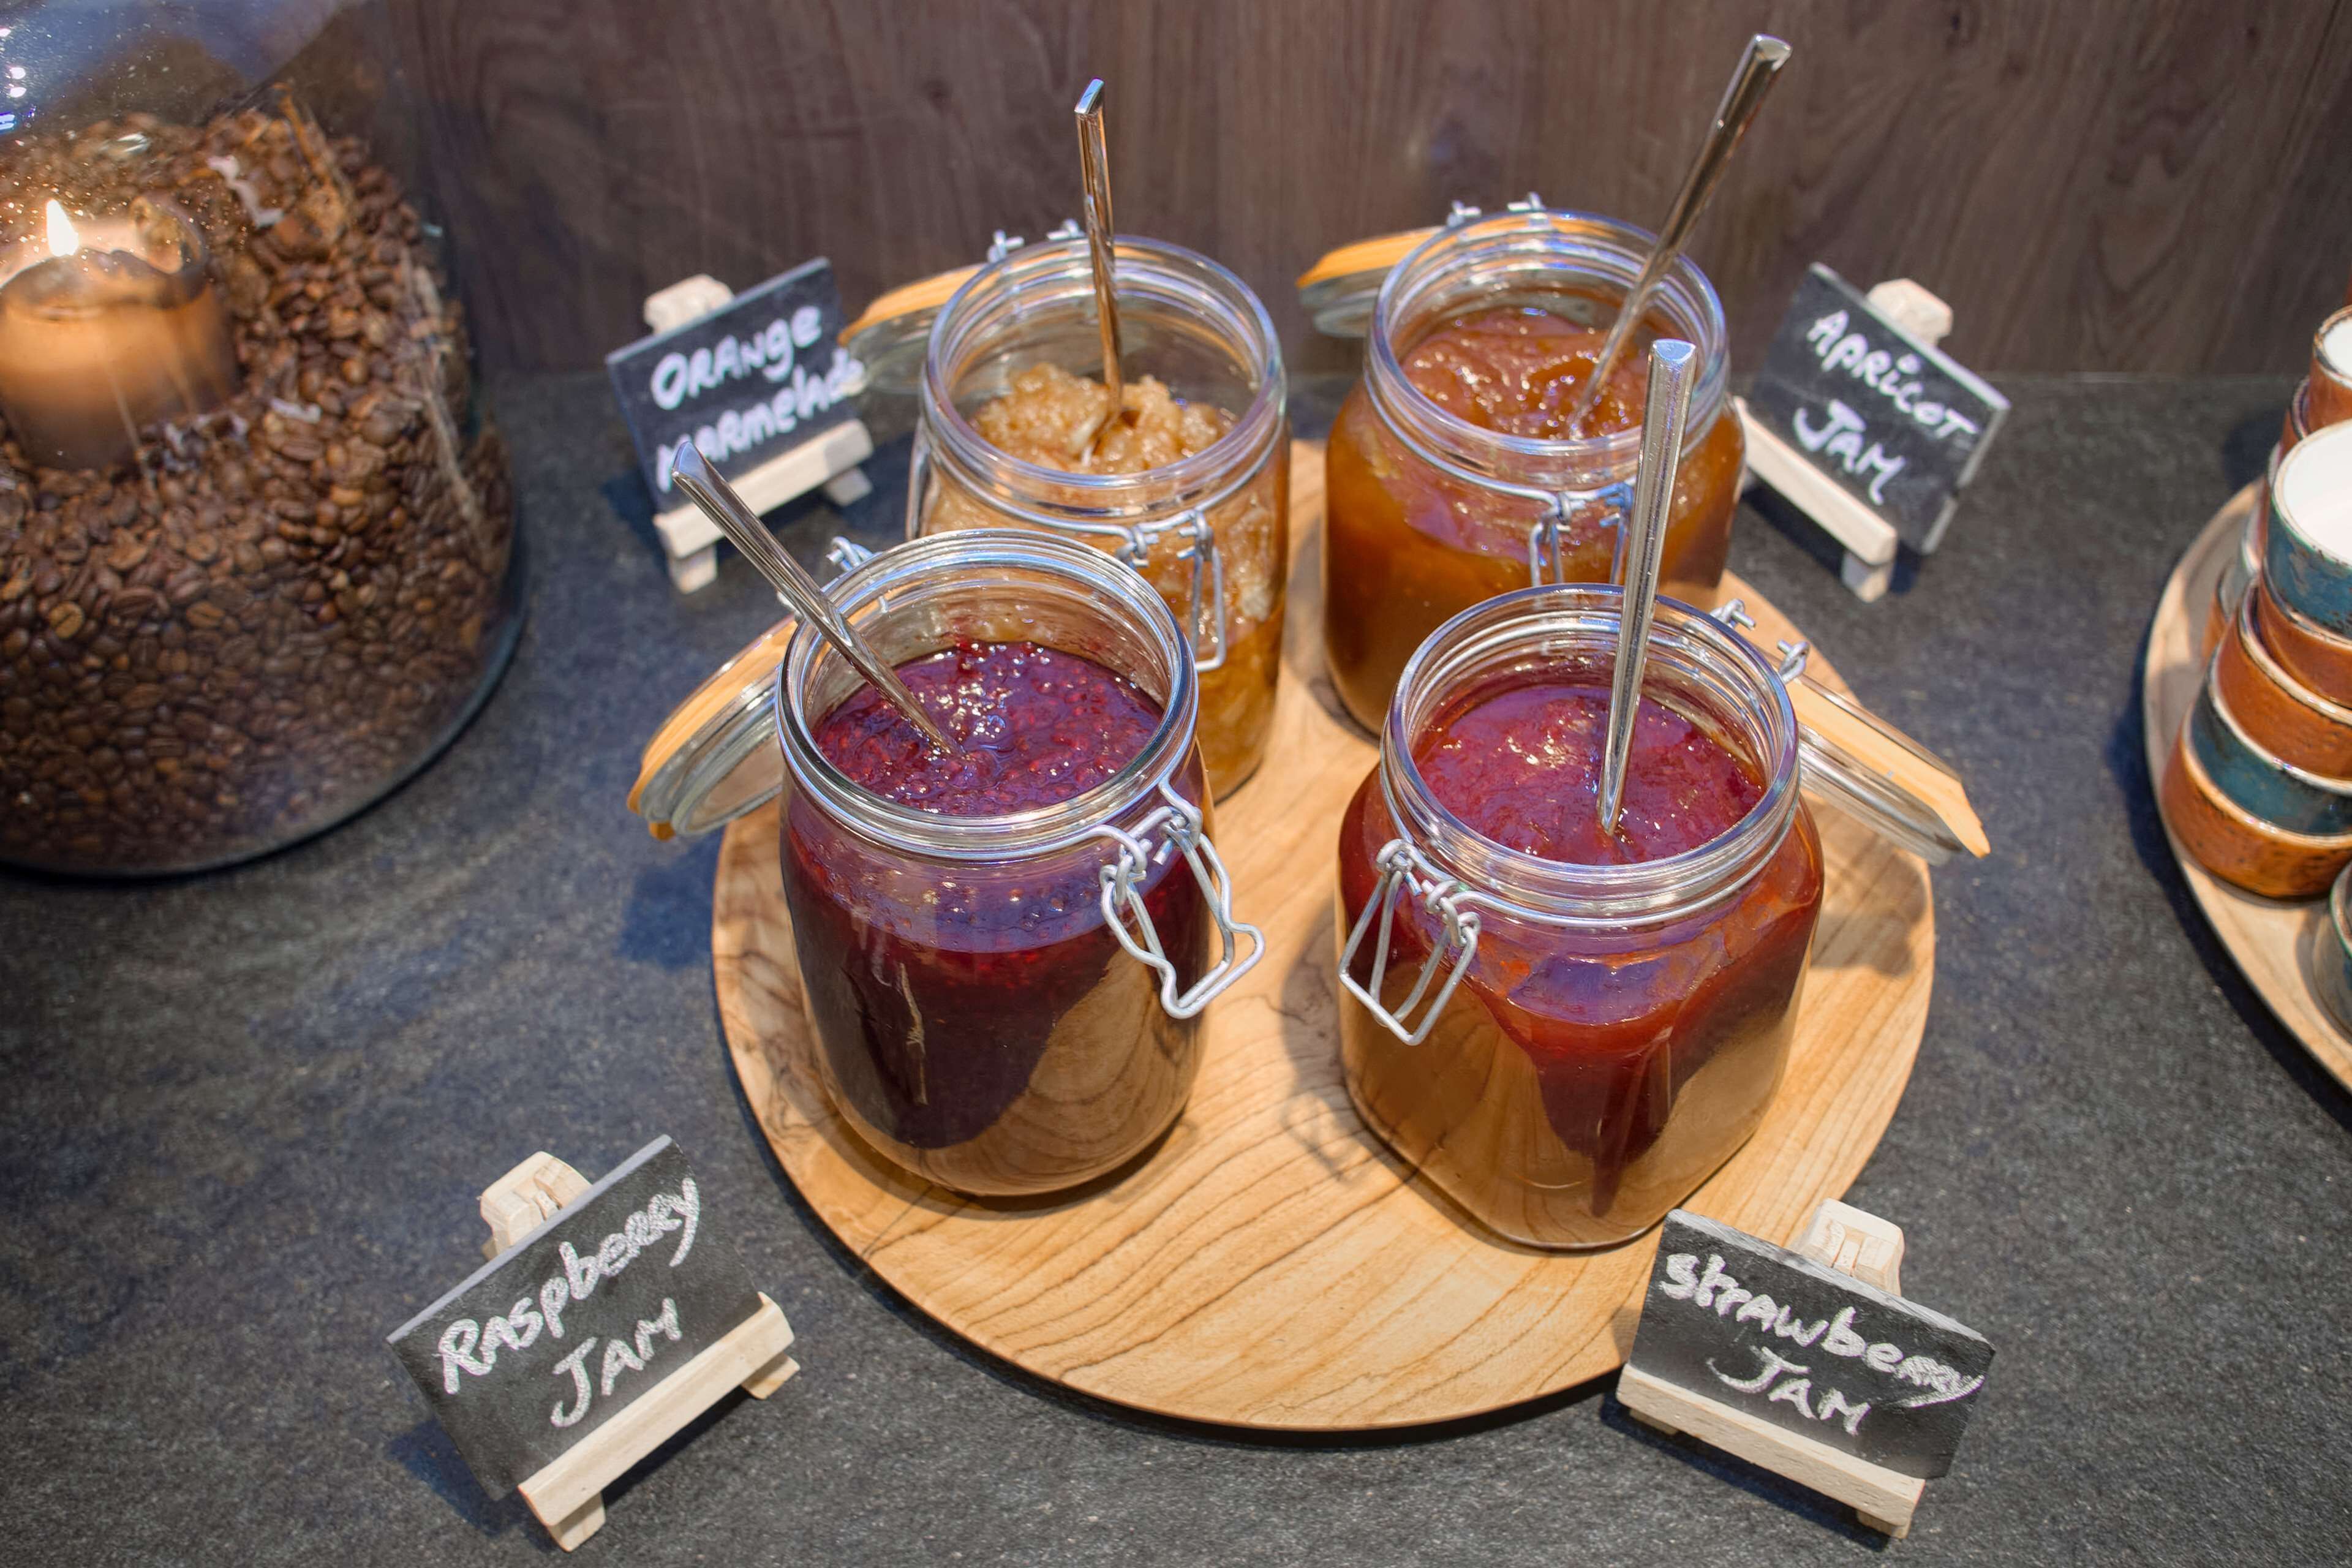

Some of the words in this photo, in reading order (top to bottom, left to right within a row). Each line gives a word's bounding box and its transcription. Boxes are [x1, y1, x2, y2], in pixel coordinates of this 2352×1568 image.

[1793, 400, 1905, 505] JAM
[551, 1298, 682, 1428] JAM
[1706, 1345, 1872, 1436] JAM
